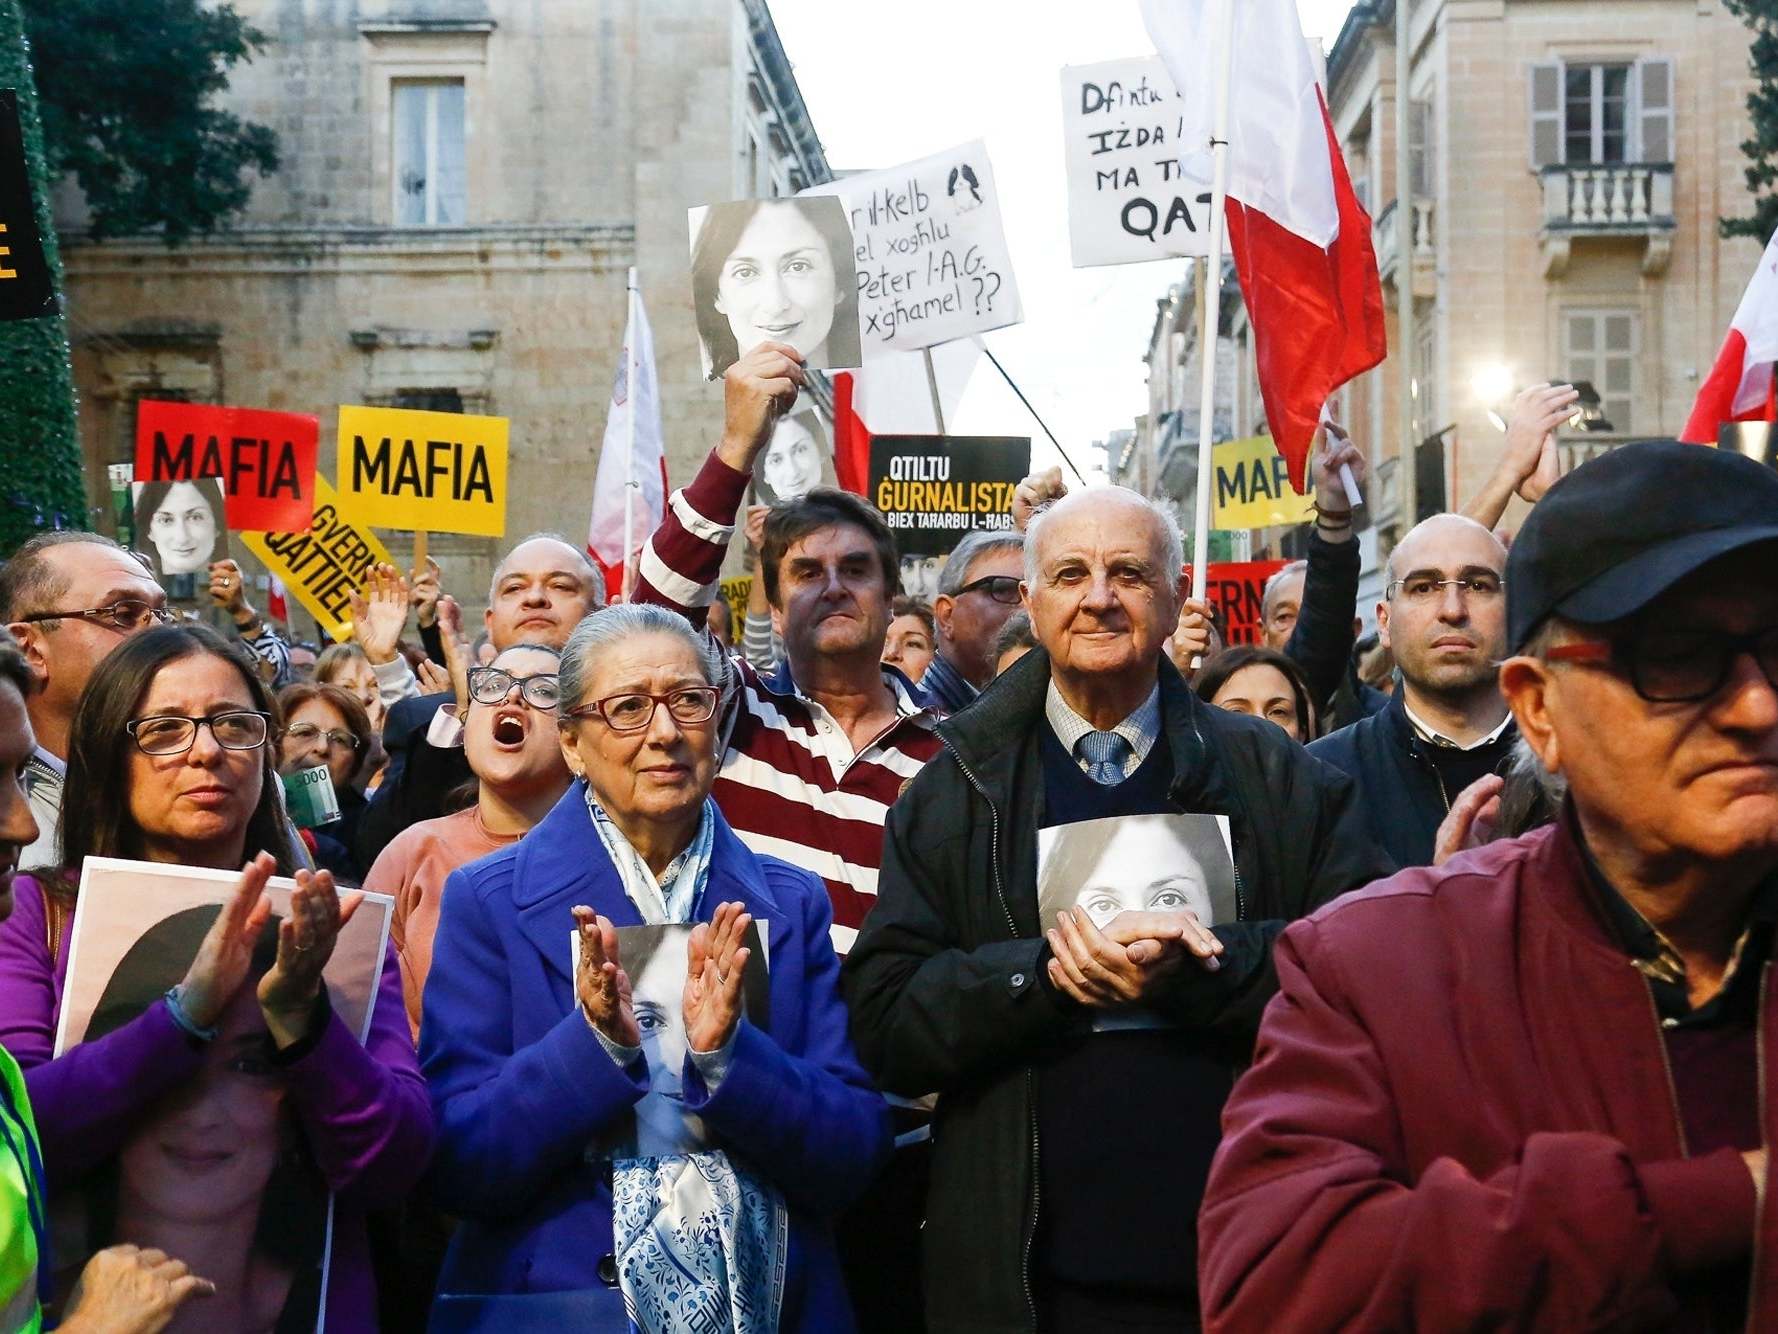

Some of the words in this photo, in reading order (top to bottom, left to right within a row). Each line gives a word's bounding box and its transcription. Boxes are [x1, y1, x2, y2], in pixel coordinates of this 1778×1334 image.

[1087, 121, 1164, 155] IŻDA
[1096, 167, 1140, 191] MA
[857, 265, 917, 299] Peter
[153, 431, 302, 500] MAFIA
[352, 434, 495, 504] MAFIA
[889, 455, 950, 482] QTILTU
[1216, 456, 1315, 508] MAF
[878, 476, 1017, 513] ĠURNALISTA
[887, 512, 914, 529] BIEX
